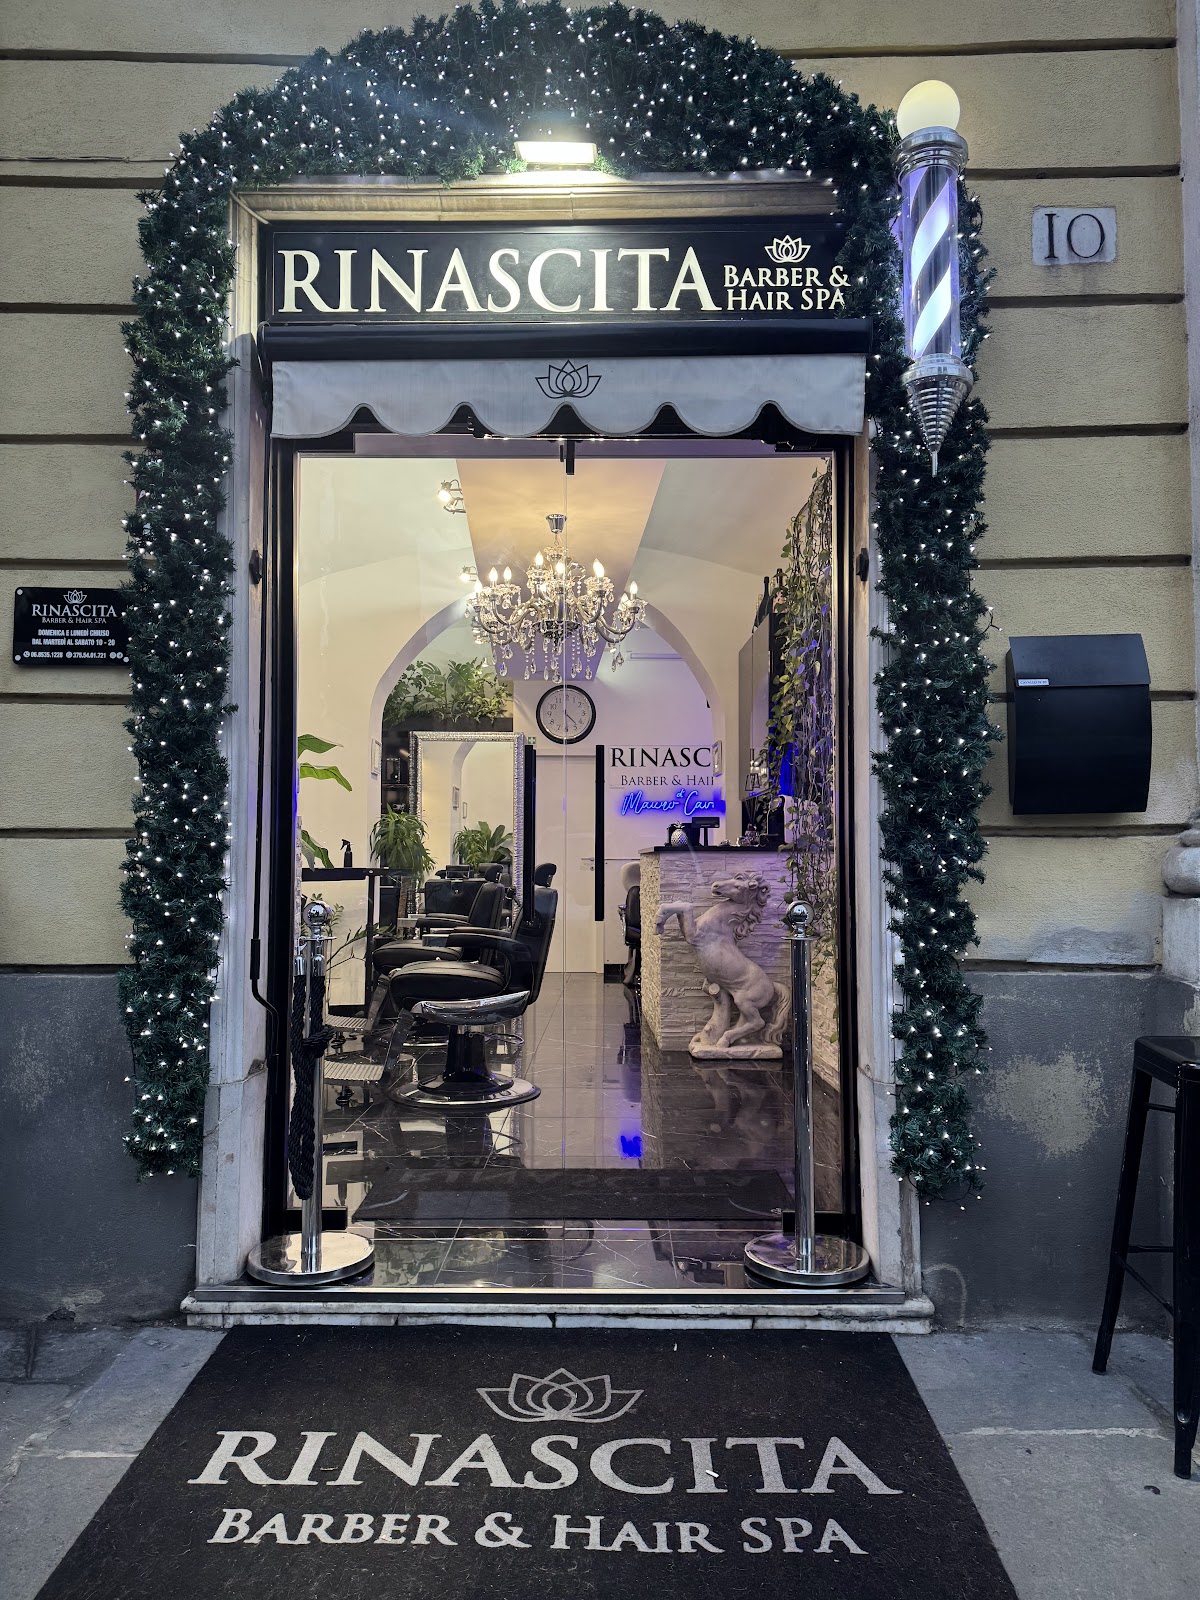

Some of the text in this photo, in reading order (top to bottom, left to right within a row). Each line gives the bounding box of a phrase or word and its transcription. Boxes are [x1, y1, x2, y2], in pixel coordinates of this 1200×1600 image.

[277, 246, 722, 313] RINASCITA
[829, 265, 851, 287] &
[801, 288, 847, 311] SPA
[31, 603, 118, 618] RINASCITA
[66, 638, 74, 646] AL
[610, 747, 711, 768] RINASC
[671, 775, 682, 786] &
[621, 790, 680, 815] Mauro
[187, 1430, 903, 1495] RINASCITA
[473, 1511, 532, 1549] &
[742, 1517, 870, 1556] SPA
